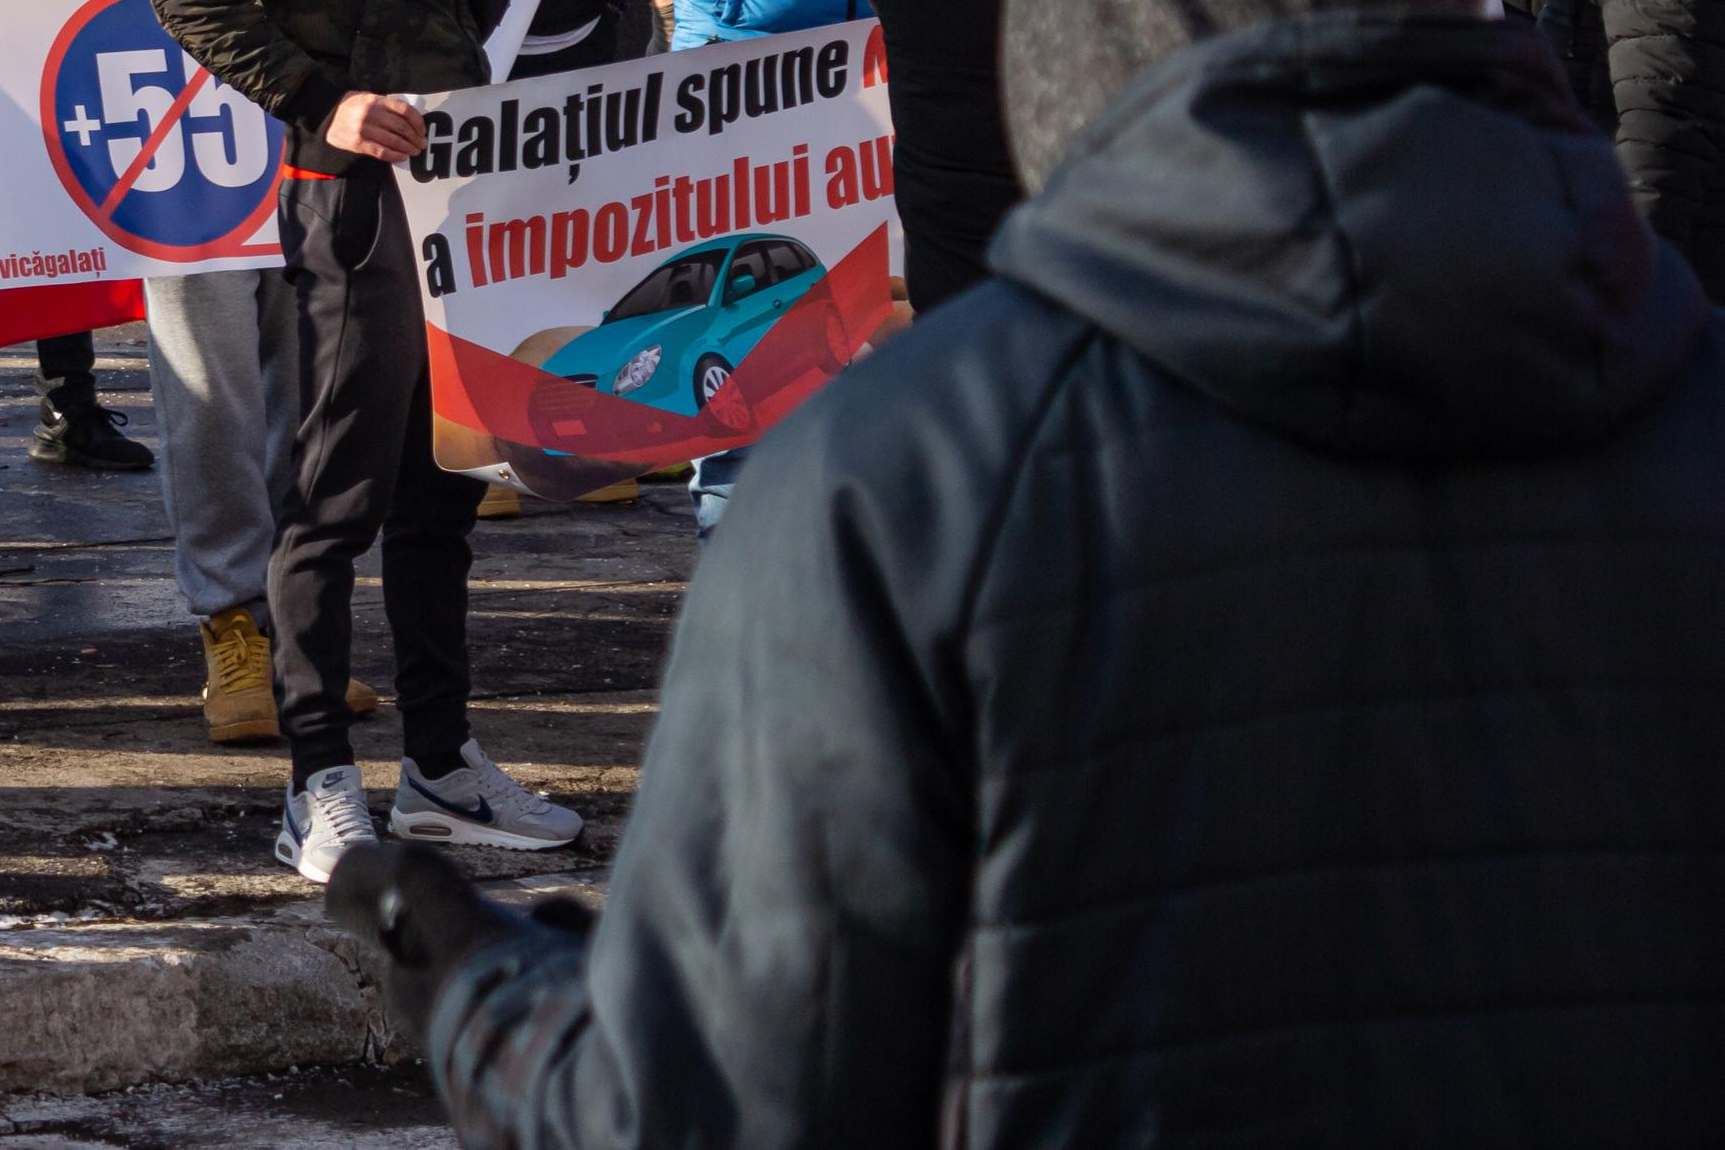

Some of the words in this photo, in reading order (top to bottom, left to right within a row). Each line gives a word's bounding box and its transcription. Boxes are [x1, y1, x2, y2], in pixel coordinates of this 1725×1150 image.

[410, 71, 664, 185] Galațiul
[675, 40, 849, 135] spune
[422, 232, 457, 299] a
[465, 143, 810, 289] impozitului
[825, 133, 898, 210] au
